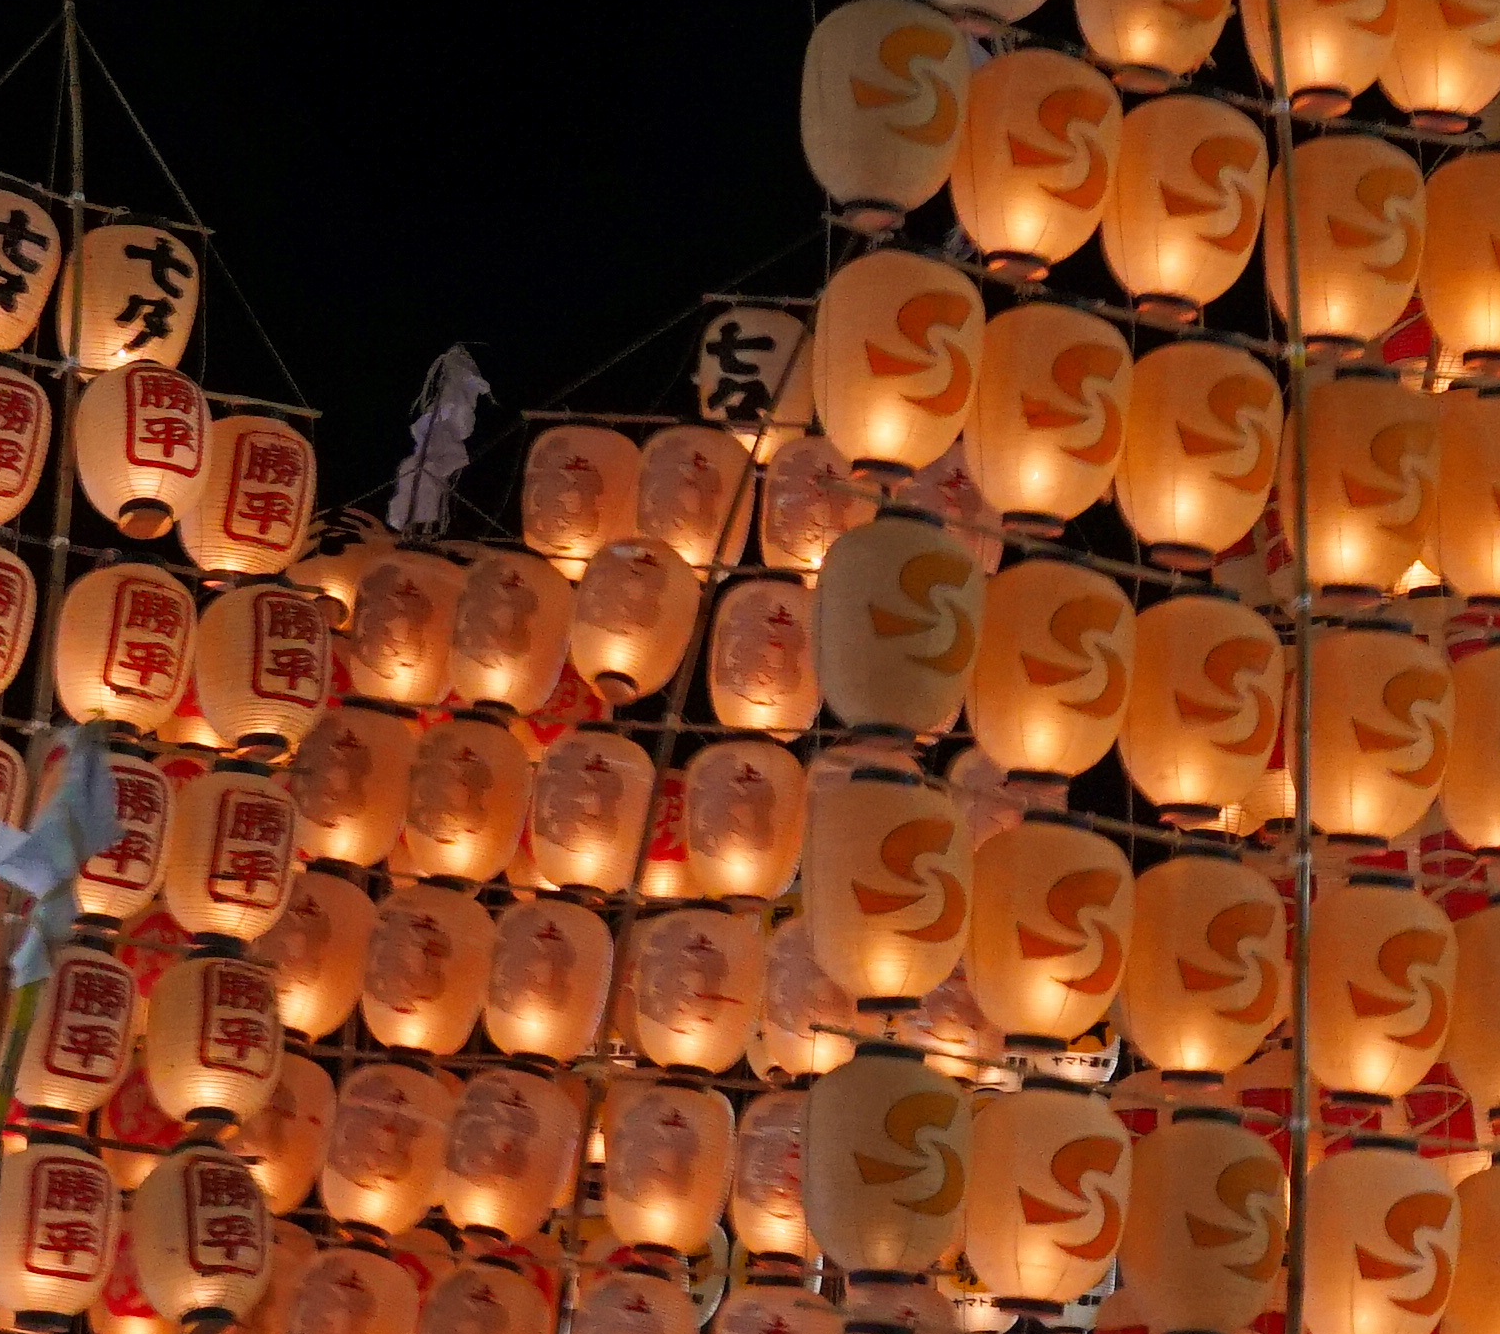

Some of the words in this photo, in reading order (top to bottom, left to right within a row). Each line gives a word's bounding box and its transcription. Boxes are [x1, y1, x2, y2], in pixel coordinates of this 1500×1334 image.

[114, 237, 195, 353] 七夕
[139, 372, 198, 459] 勝平
[239, 444, 300, 536] 勝平
[120, 601, 186, 688] 勝平
[265, 601, 322, 691] 勝平
[226, 802, 291, 895] 勝平
[62, 969, 130, 1070] 勝平
[212, 962, 276, 1059] 勝平
[40, 1168, 104, 1268] 勝平
[198, 1160, 265, 1262] 勝平
